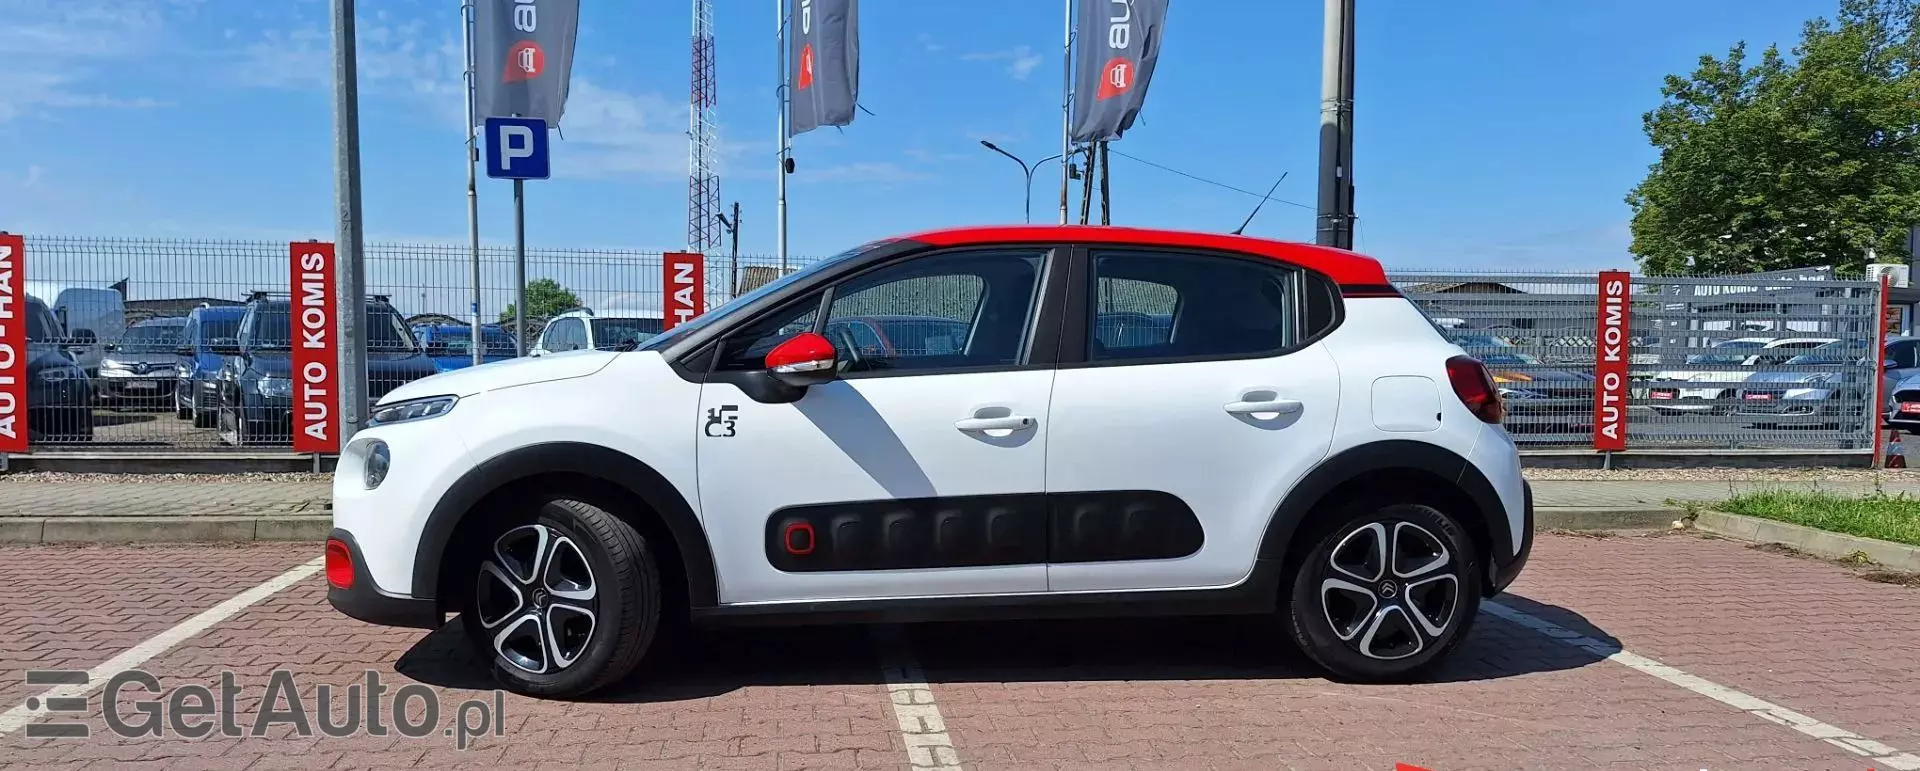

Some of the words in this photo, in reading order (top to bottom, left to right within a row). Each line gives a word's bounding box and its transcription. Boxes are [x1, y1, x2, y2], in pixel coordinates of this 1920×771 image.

[514, 0, 536, 33] a
[500, 126, 534, 170] P
[301, 252, 326, 349] KOMIS
[1604, 279, 1623, 362] KOMIS
[303, 361, 328, 441] AUTO
[1602, 372, 1620, 440] AUTO
